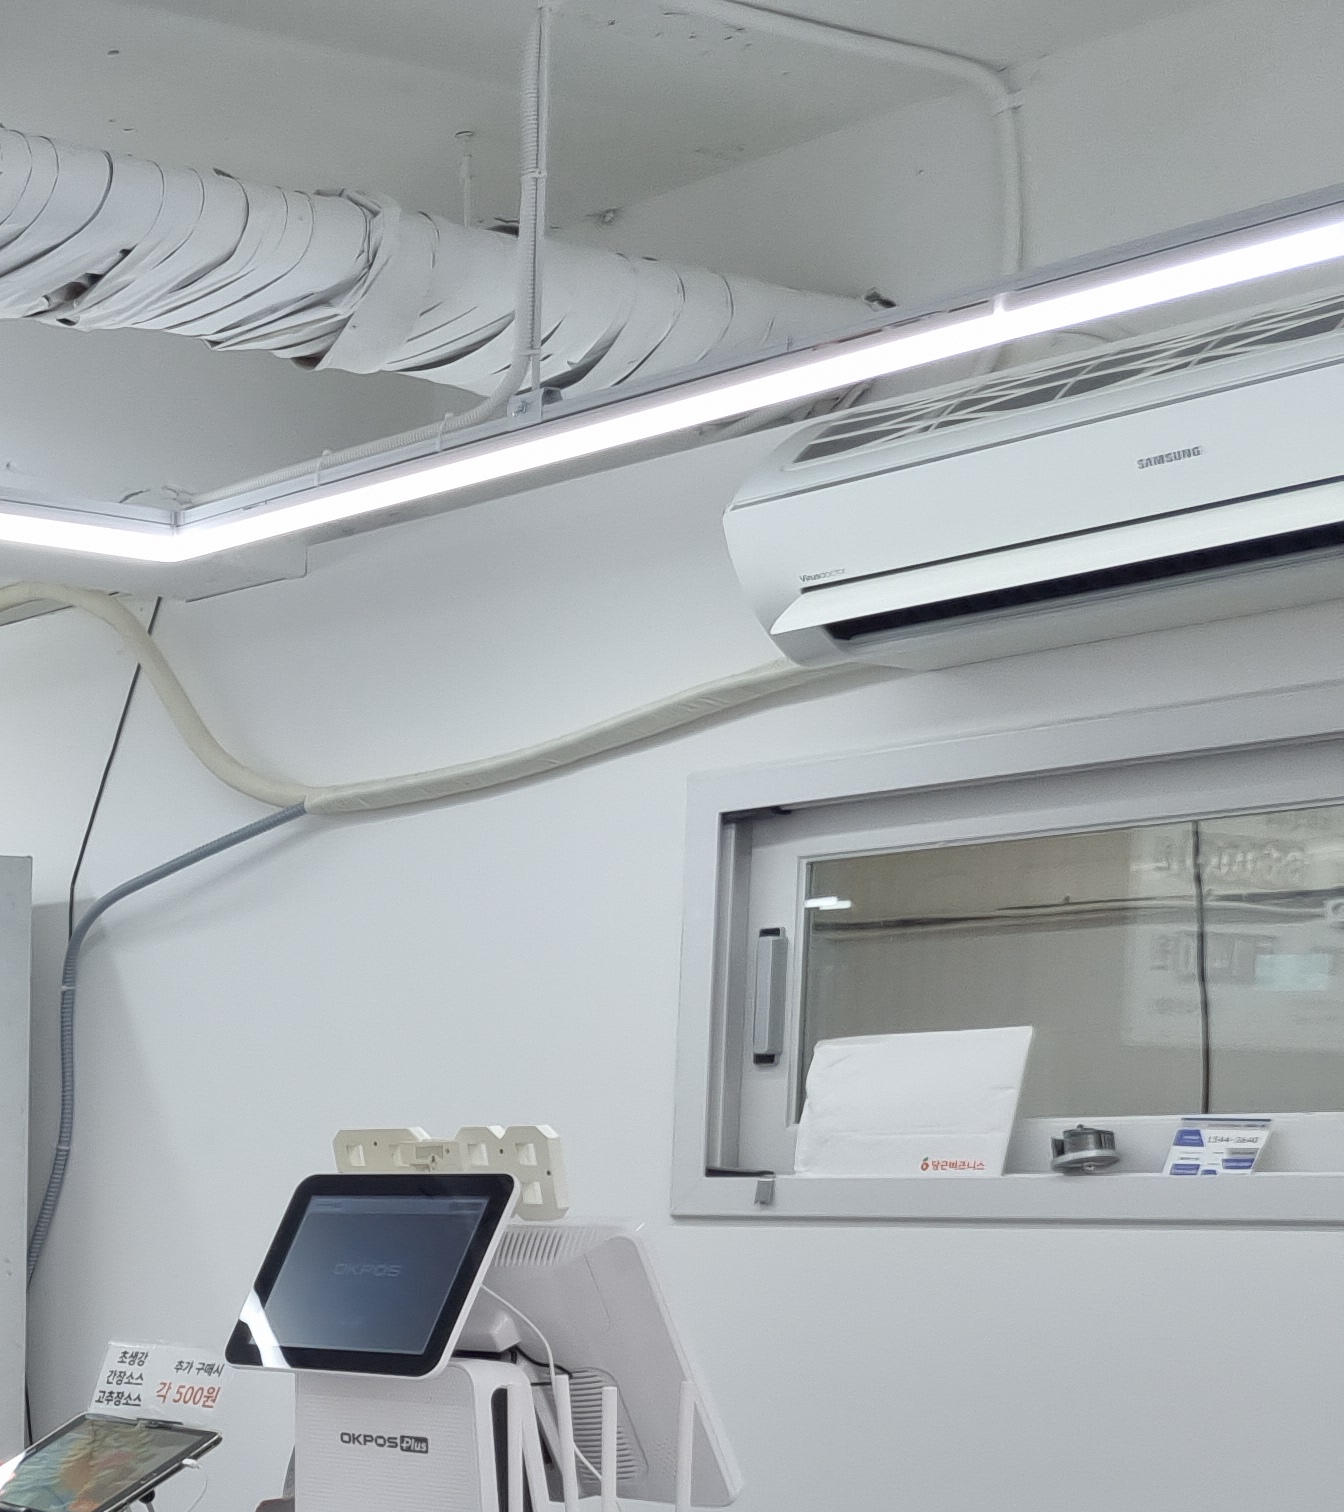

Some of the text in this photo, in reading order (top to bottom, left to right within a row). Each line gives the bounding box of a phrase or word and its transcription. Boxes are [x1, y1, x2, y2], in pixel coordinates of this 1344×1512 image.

[1137, 446, 1201, 469] SAMSUNG
[333, 1263, 402, 1277] OKPOS
[117, 1350, 148, 1366] 초생강
[174, 1360, 225, 1378] 추가 구매시
[106, 1370, 144, 1386] 간장소스
[94, 1390, 141, 1406] 고추장소스
[156, 1382, 221, 1408] 각 500원
[340, 1432, 398, 1448] OKPOS
